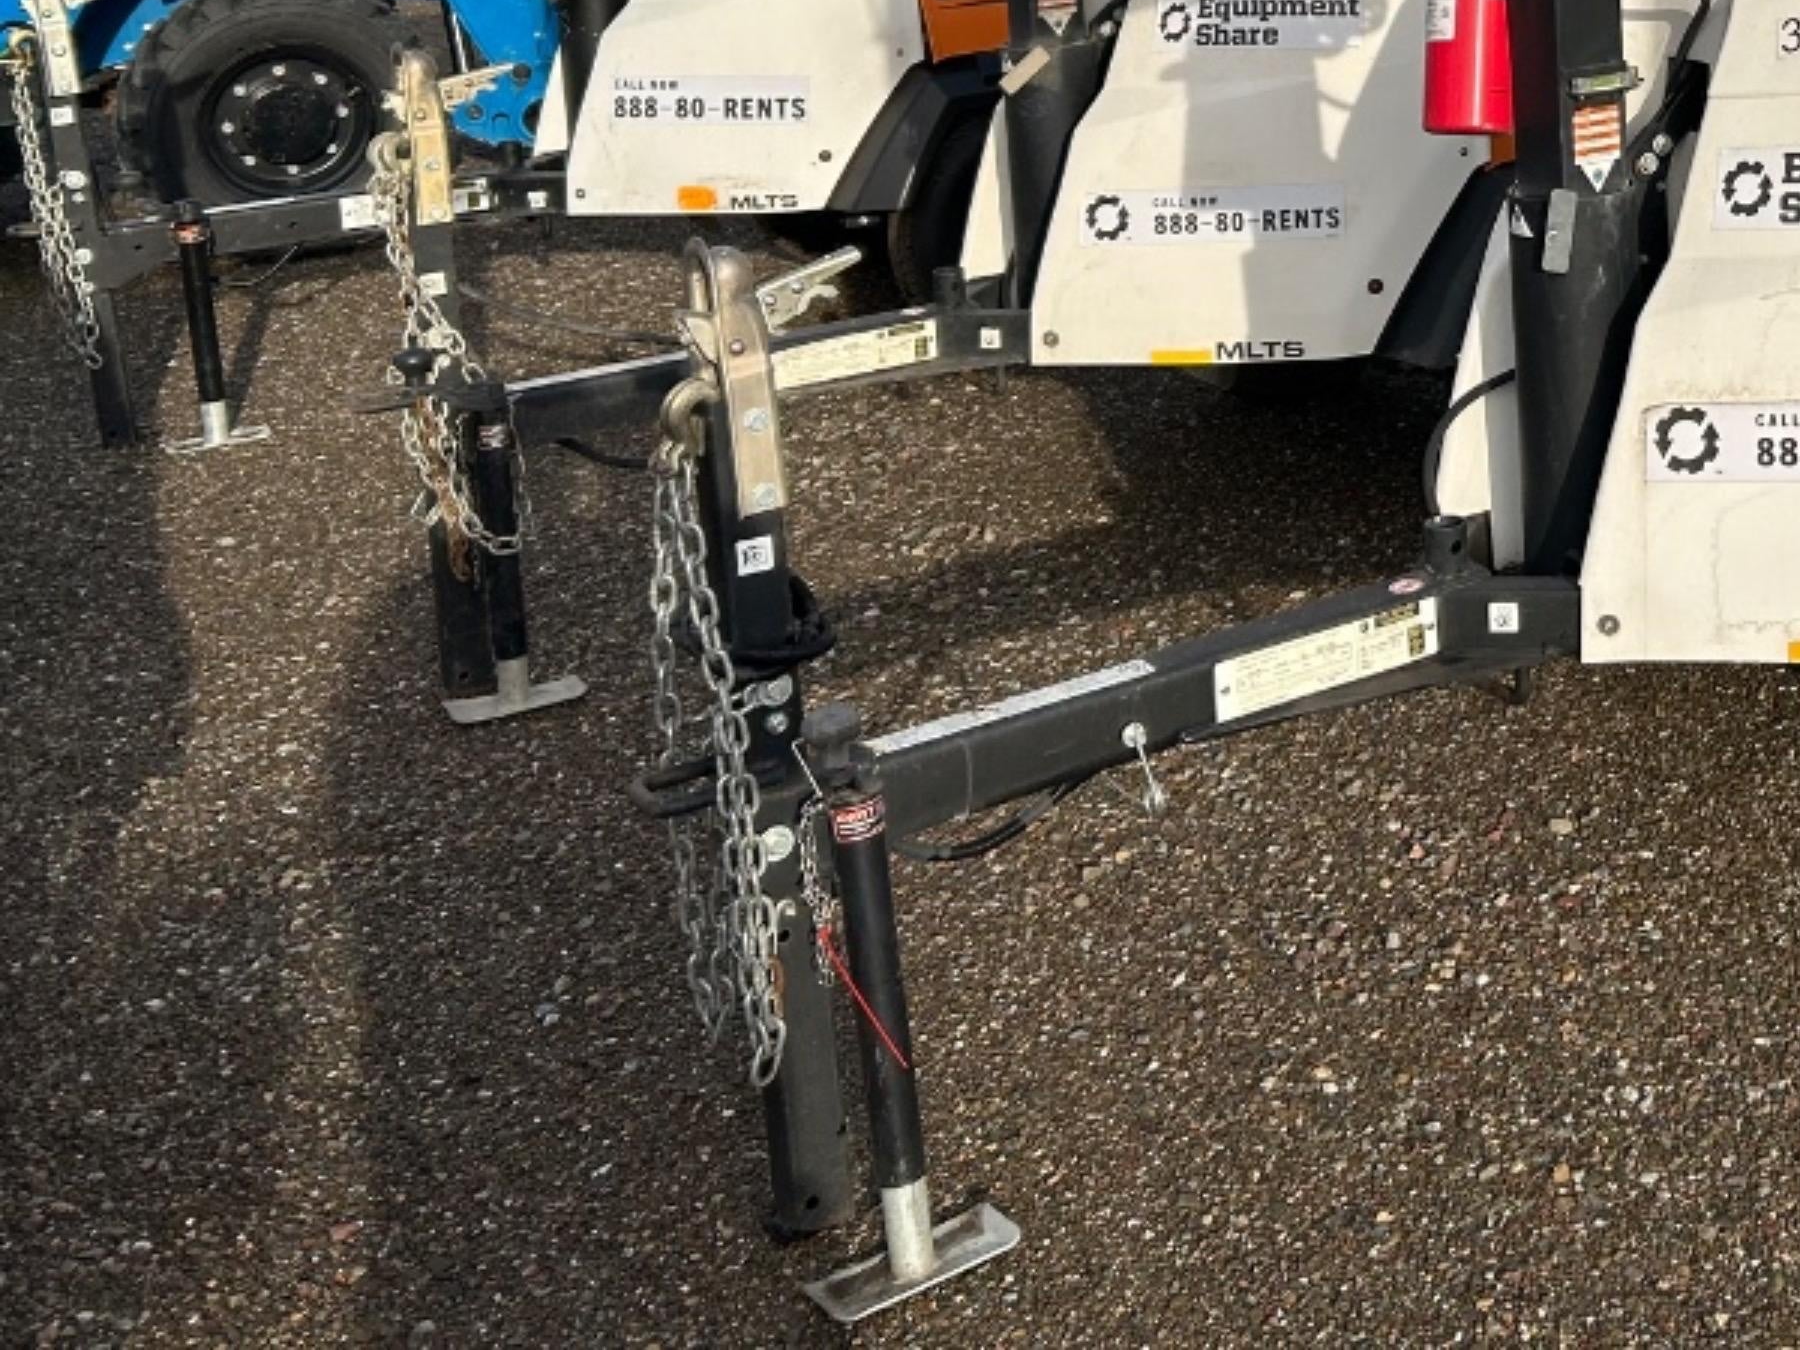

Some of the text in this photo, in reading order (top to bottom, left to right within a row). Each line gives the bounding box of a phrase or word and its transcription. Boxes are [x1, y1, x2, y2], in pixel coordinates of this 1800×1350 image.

[1195, 23, 1280, 47] Share
[613, 95, 806, 120] 888-80-RENTS
[730, 194, 799, 210] MLTS
[1154, 208, 1340, 235] 888-80-RENTS
[1216, 341, 1305, 360] MLTS
[1755, 413, 1800, 427] CALL
